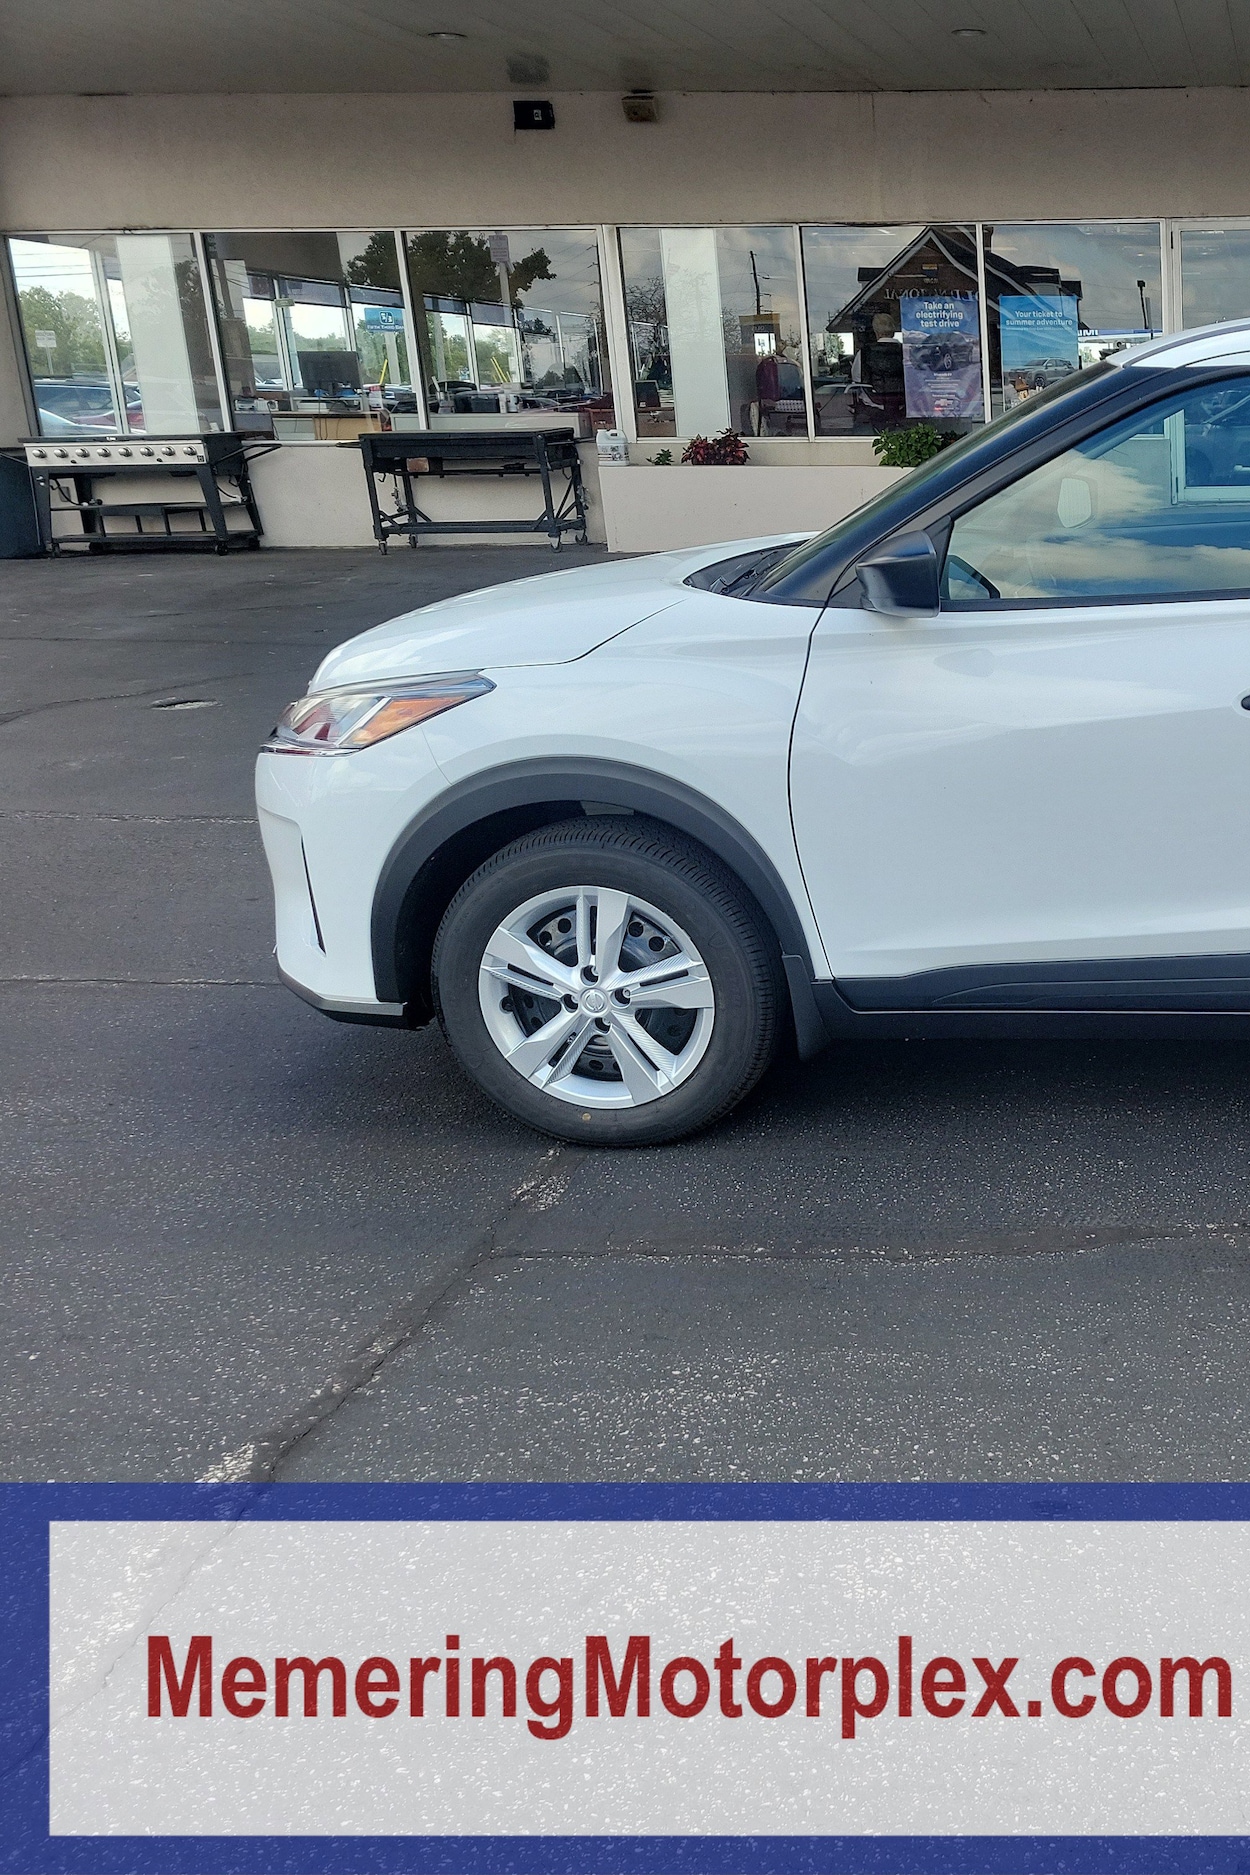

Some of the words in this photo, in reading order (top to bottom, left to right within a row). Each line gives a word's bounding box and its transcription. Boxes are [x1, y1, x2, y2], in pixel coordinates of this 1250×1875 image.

[924, 301, 943, 310] Take
[915, 311, 964, 320] electrifying
[1015, 310, 1032, 318] Your
[1033, 310, 1054, 318] ticket
[920, 320, 938, 328] test
[939, 319, 960, 328] drive
[1036, 318, 1073, 326] adventure
